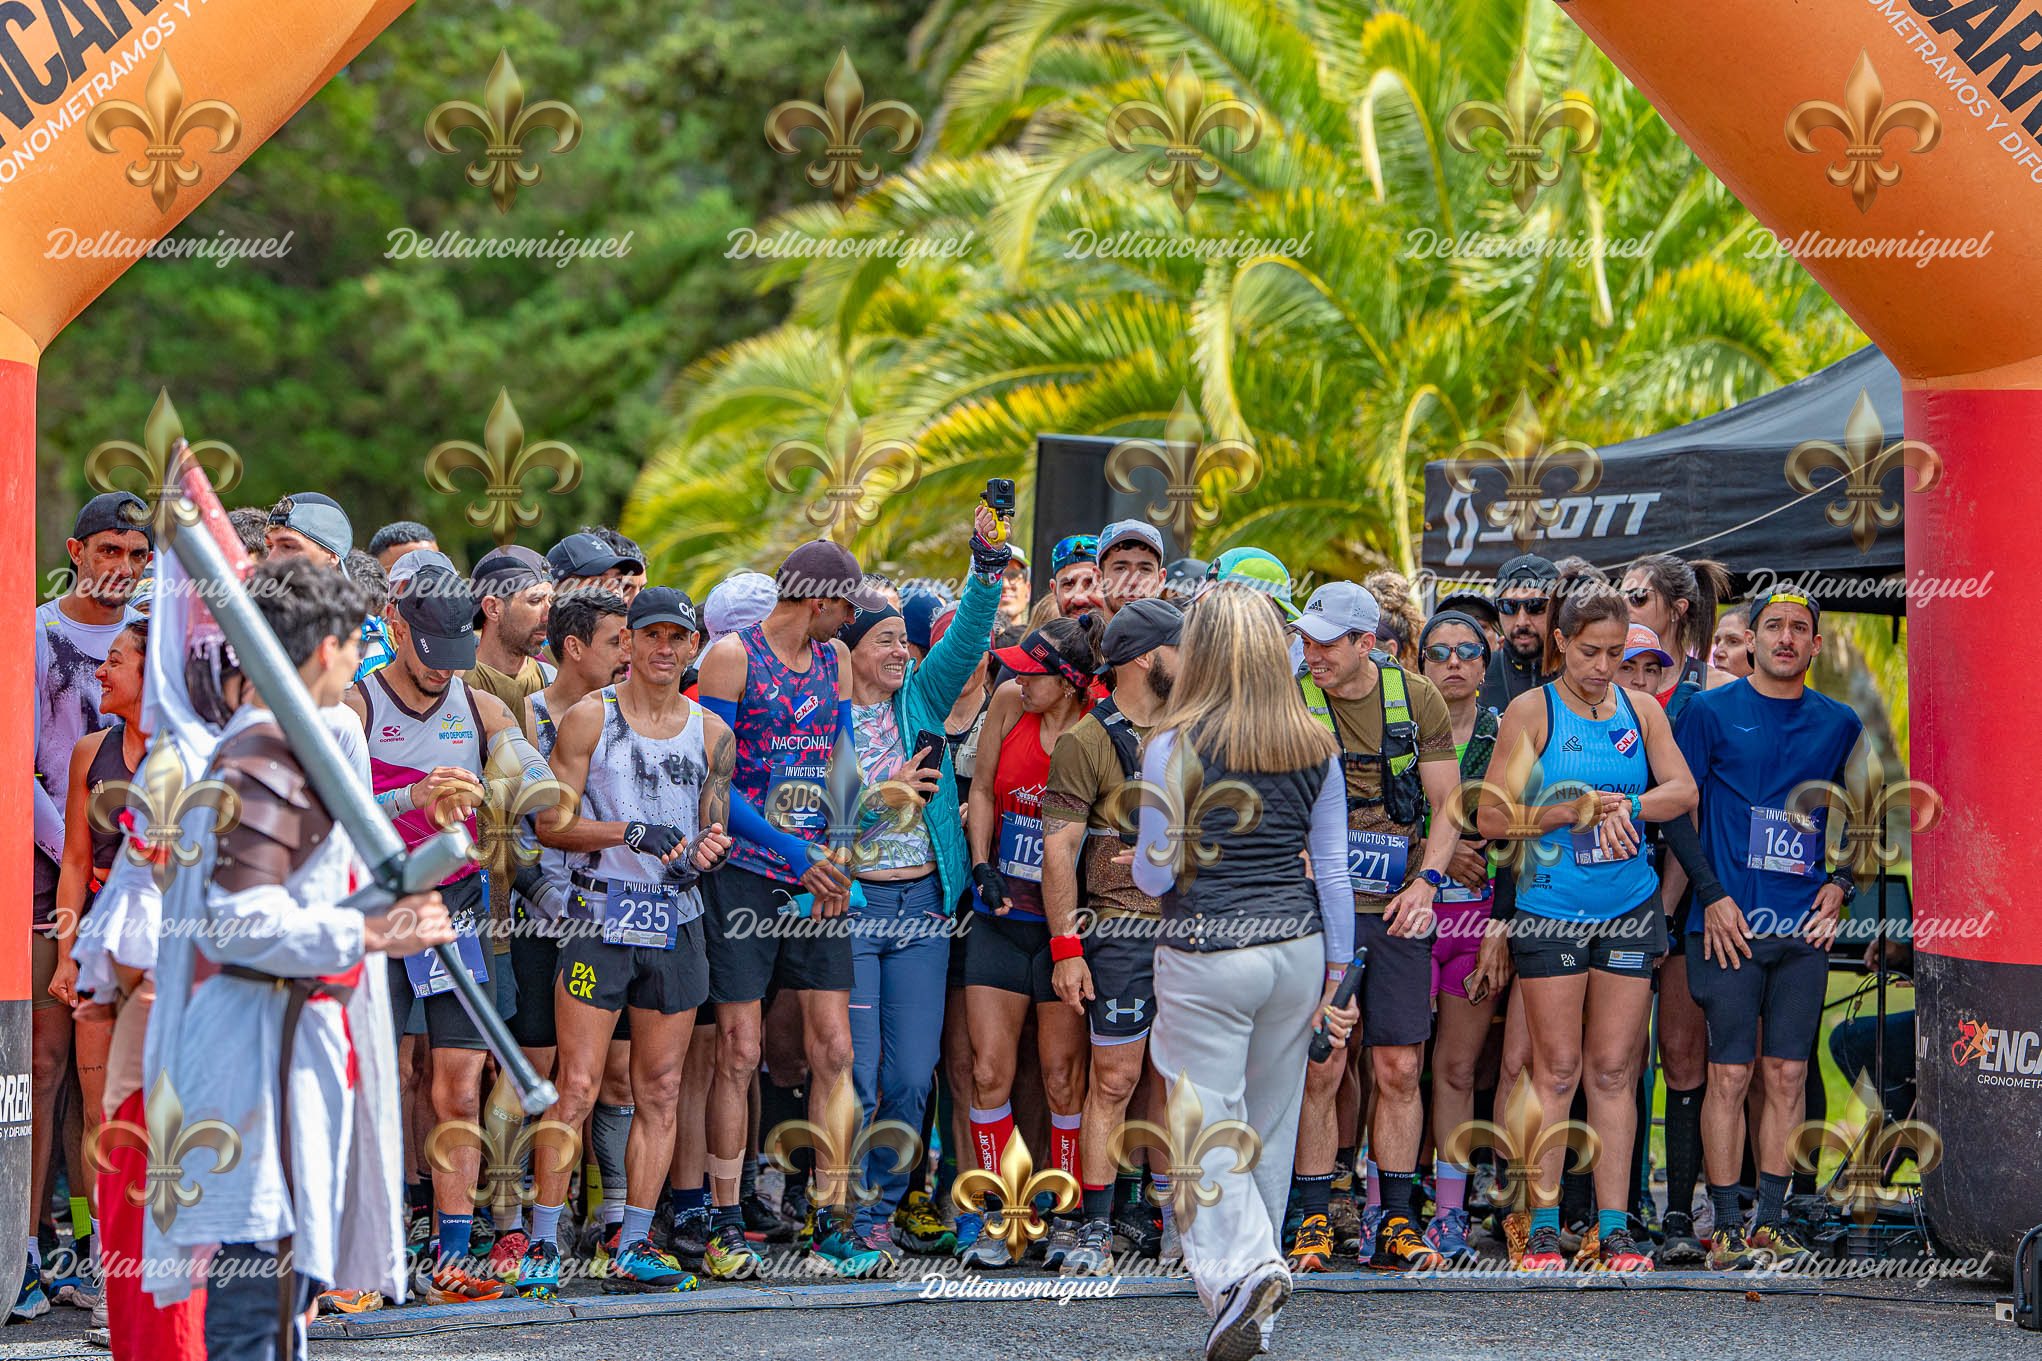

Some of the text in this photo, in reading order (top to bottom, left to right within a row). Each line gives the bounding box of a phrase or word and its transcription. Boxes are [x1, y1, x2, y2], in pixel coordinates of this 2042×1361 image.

[0, 11, 177, 193] ONOMETRAMOS
[1985, 113, 2009, 132] Y
[771, 736, 832, 750] NACIONAL
[785, 766, 816, 778] INVICTUS
[776, 783, 822, 813] 308
[1766, 809, 1801, 824] INVICTUS
[1348, 831, 1406, 849] INVICTUS 15K
[1765, 827, 1804, 859] 166
[1348, 849, 1390, 880] 271
[623, 880, 662, 894] INVICTUS
[618, 899, 670, 932] 235
